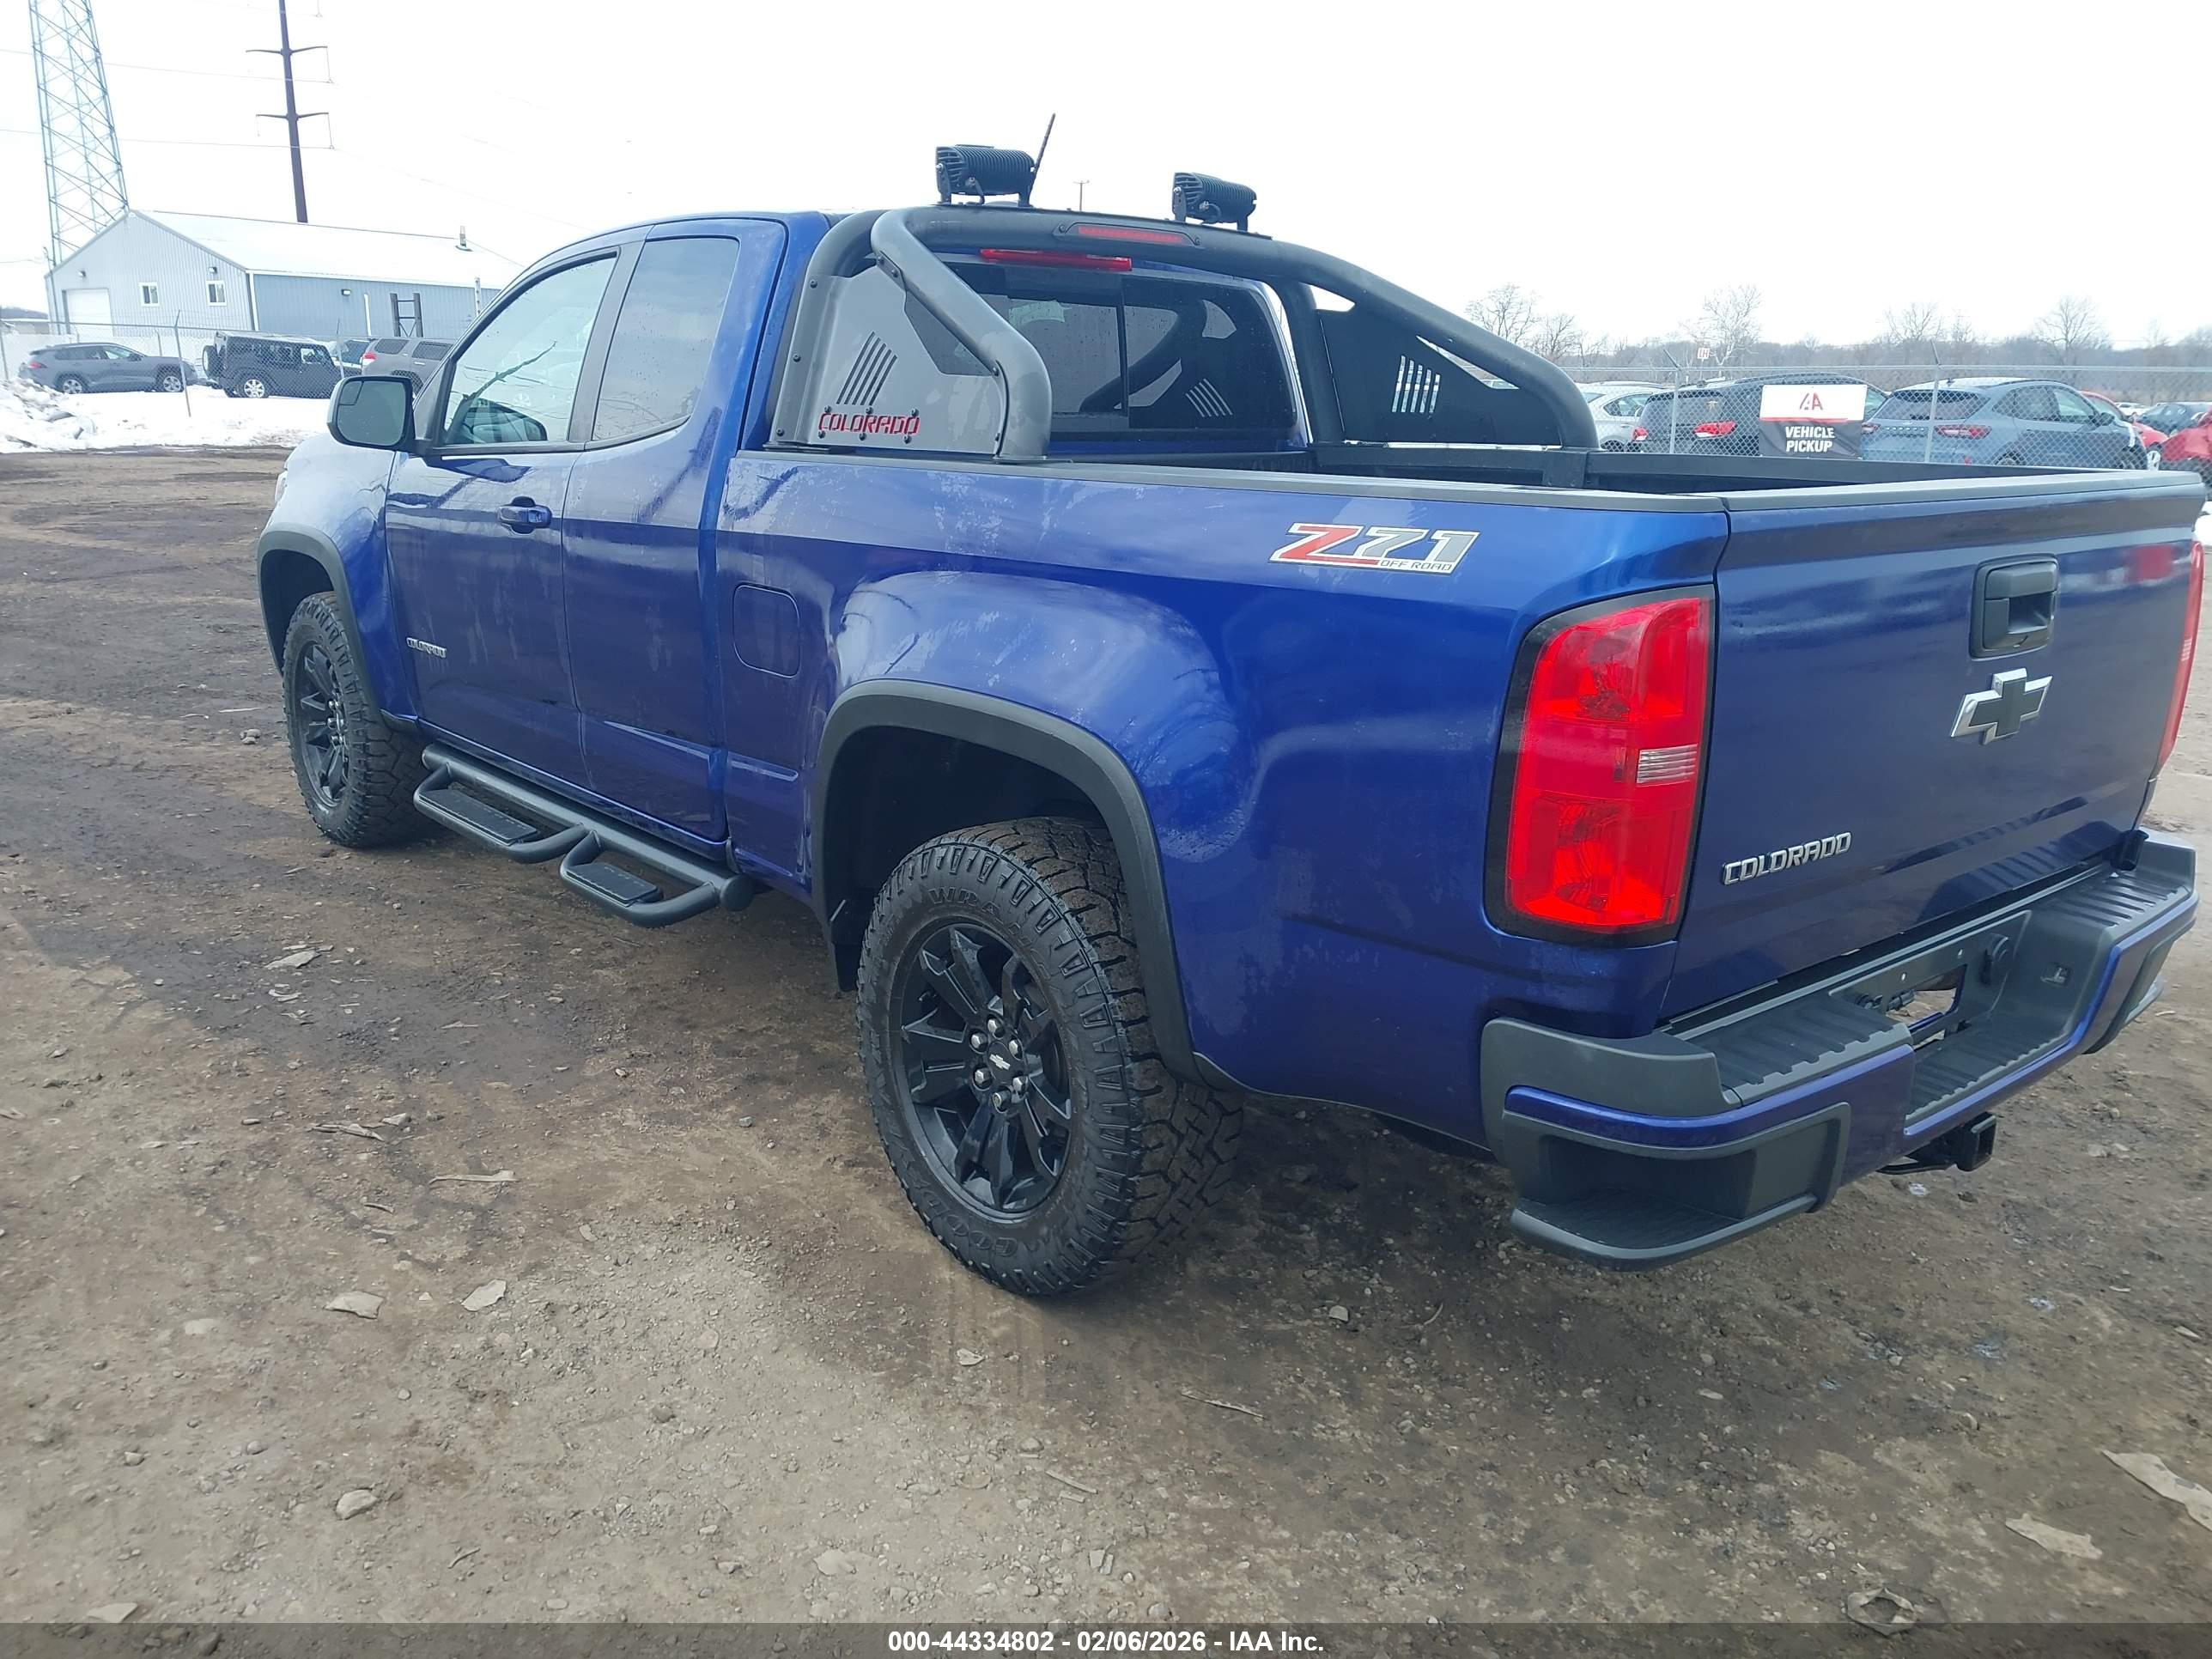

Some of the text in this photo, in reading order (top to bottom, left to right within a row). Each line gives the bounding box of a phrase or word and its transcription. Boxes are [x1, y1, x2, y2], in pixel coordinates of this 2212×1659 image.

[818, 412, 921, 434] COLORADO
[1785, 426, 1836, 439] VEHICLE
[1785, 440, 1833, 453] PICKUP
[1269, 522, 1480, 572] Z71
[1380, 559, 1453, 572] OFF ROAD
[1723, 832, 1852, 885] COLORADO
